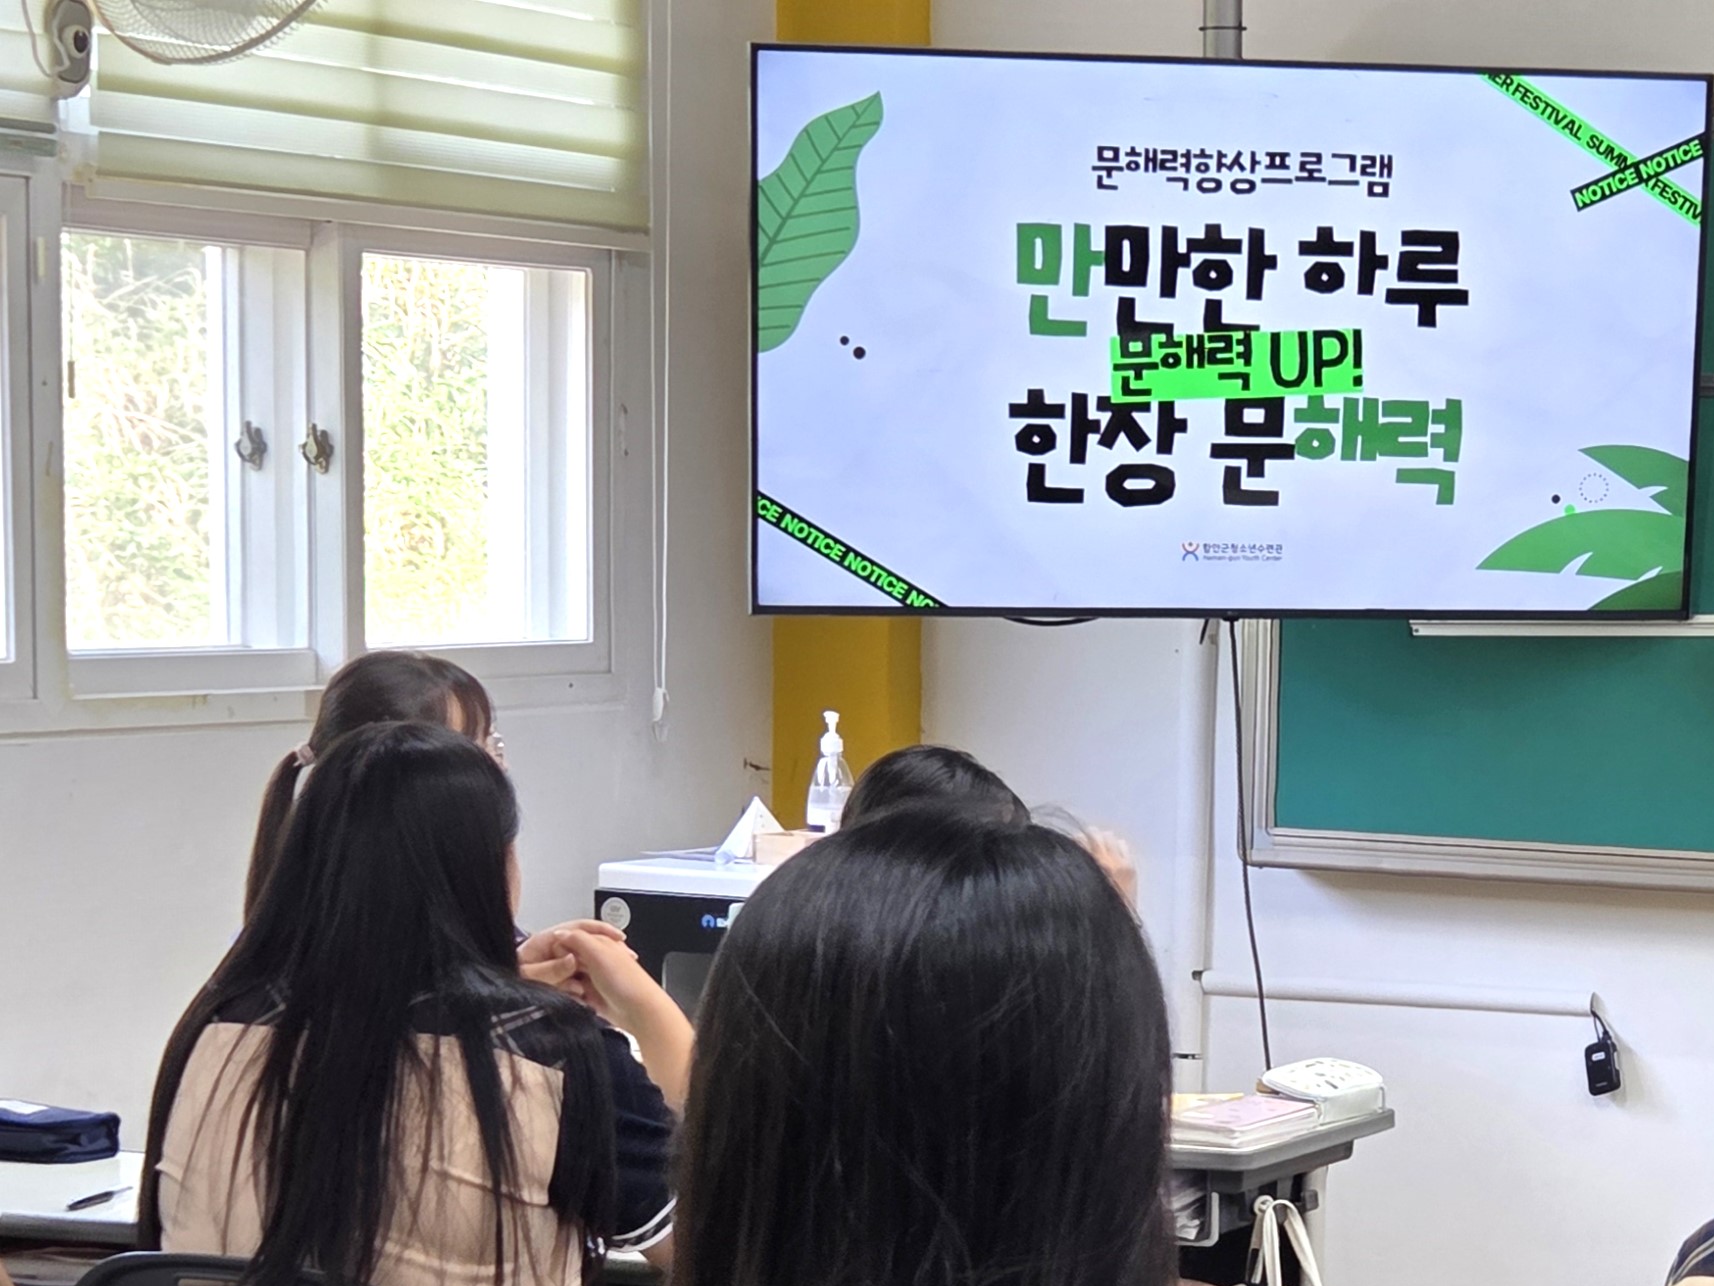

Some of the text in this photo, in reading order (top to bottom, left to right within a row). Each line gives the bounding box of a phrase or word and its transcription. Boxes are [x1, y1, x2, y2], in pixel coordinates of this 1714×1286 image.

[1511, 83, 1583, 142] FESTIVAL
[1091, 145, 1393, 198] 문해력향상프로그램
[1574, 139, 1703, 208] NOTICE NOTICE
[1016, 222, 1469, 337] 만만한 하루
[1113, 328, 1363, 397] 문해력 UP!
[1008, 388, 1463, 508] 한장 문해력
[780, 513, 847, 562] NOTICE
[843, 551, 909, 599] NOTICE
